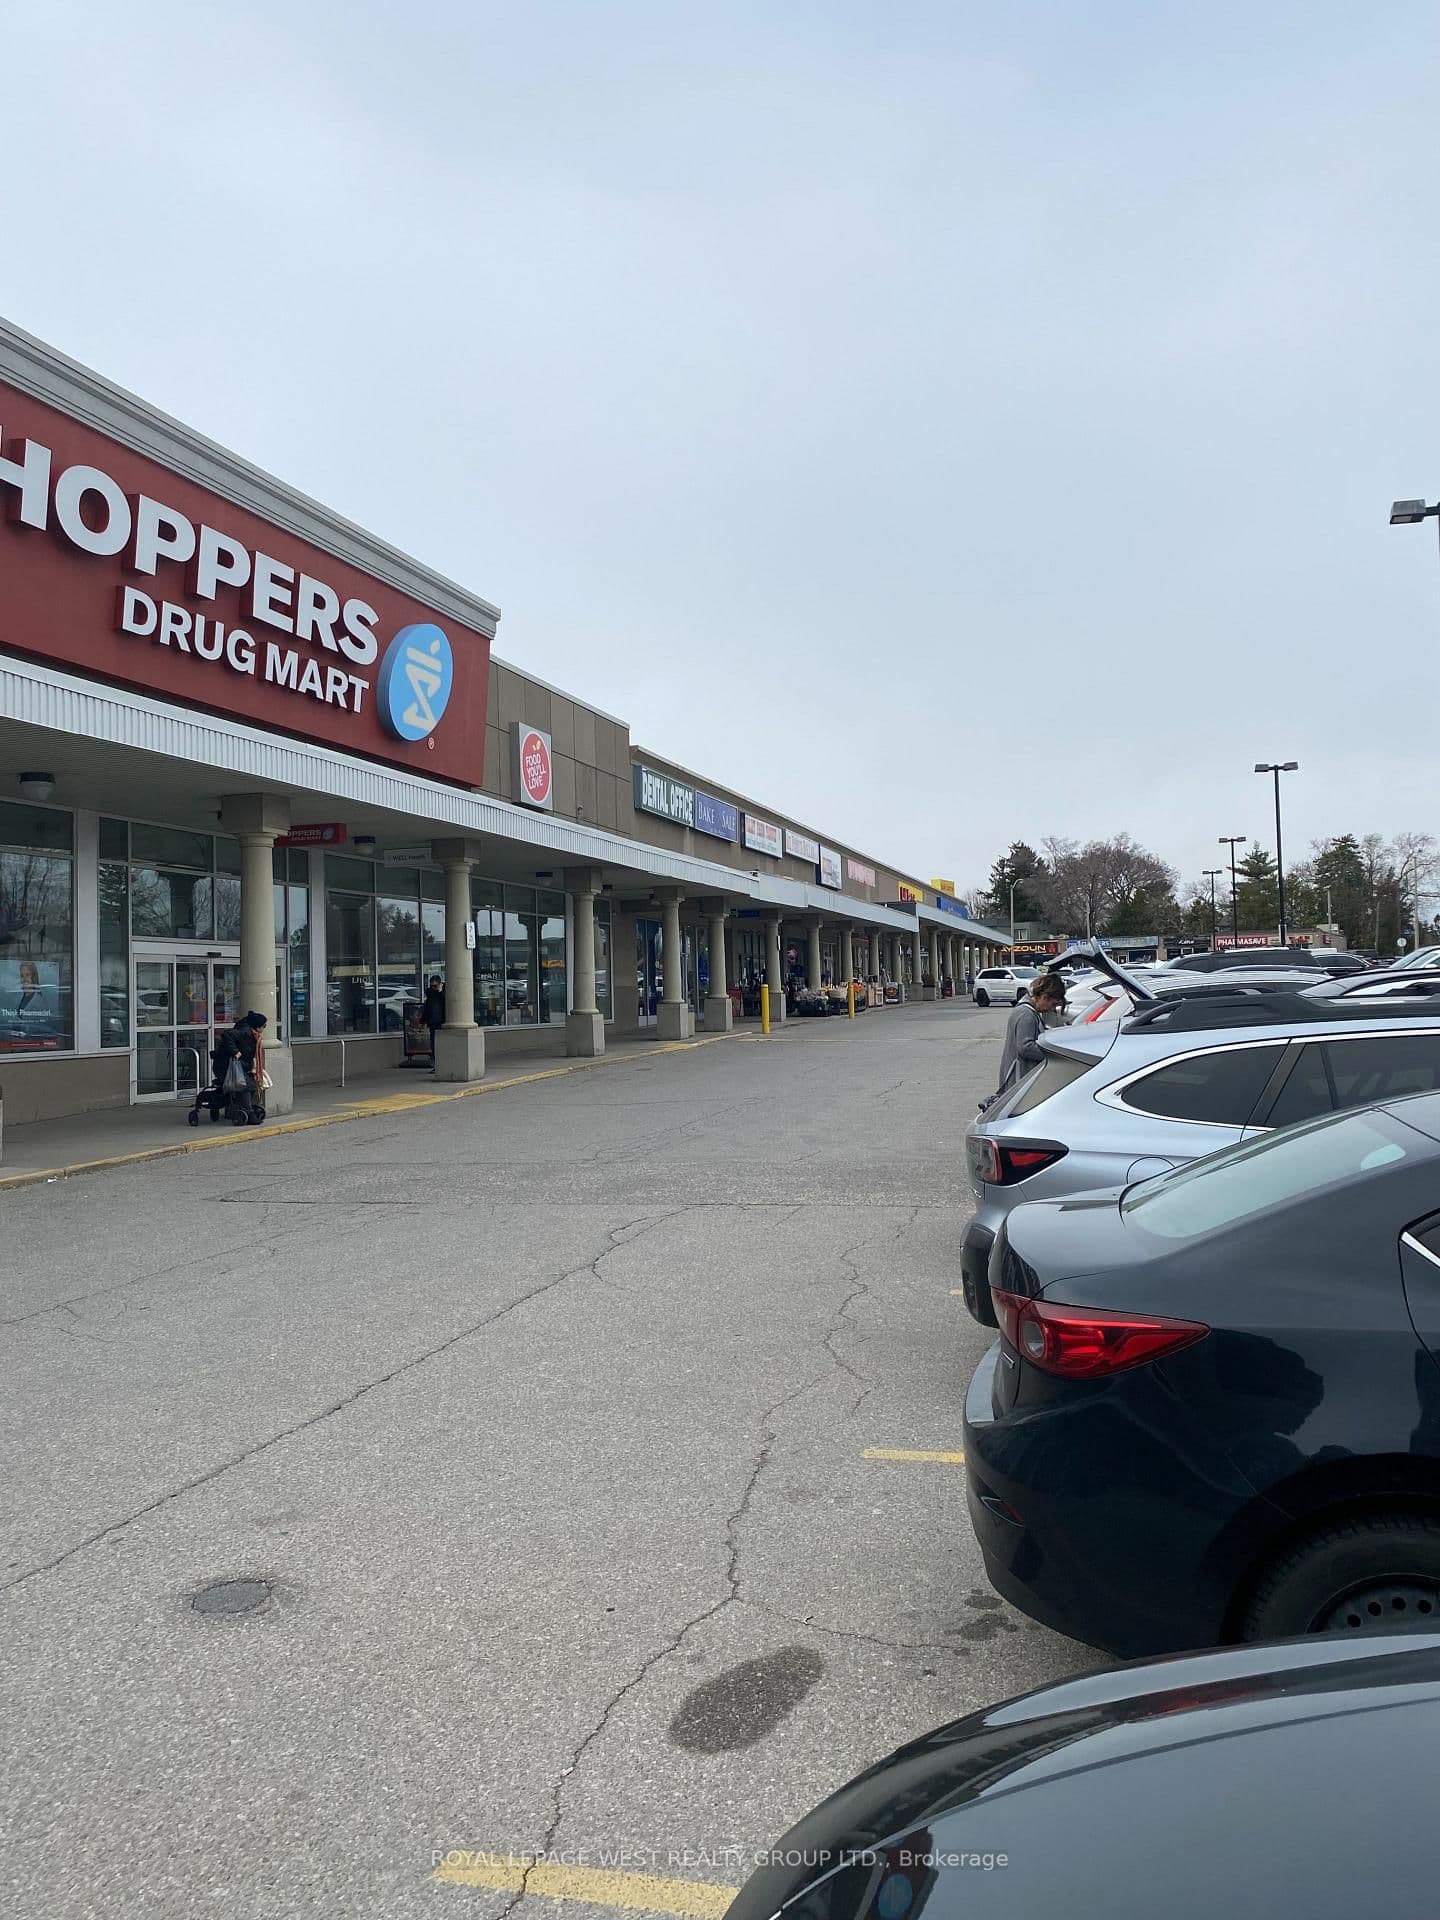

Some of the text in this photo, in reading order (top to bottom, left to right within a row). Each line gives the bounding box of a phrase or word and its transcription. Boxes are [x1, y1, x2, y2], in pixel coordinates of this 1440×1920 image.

[0, 424, 380, 666] HOPPERS
[121, 585, 370, 714] DRUG MART
[525, 753, 541, 767] FOOD
[526, 764, 547, 778] YOU'LL
[528, 776, 544, 790] LOVE
[642, 771, 694, 827] DENTAL OFFICE
[698, 802, 715, 824] BAKE
[721, 810, 736, 831] SALE
[288, 829, 321, 837] OPPERS
